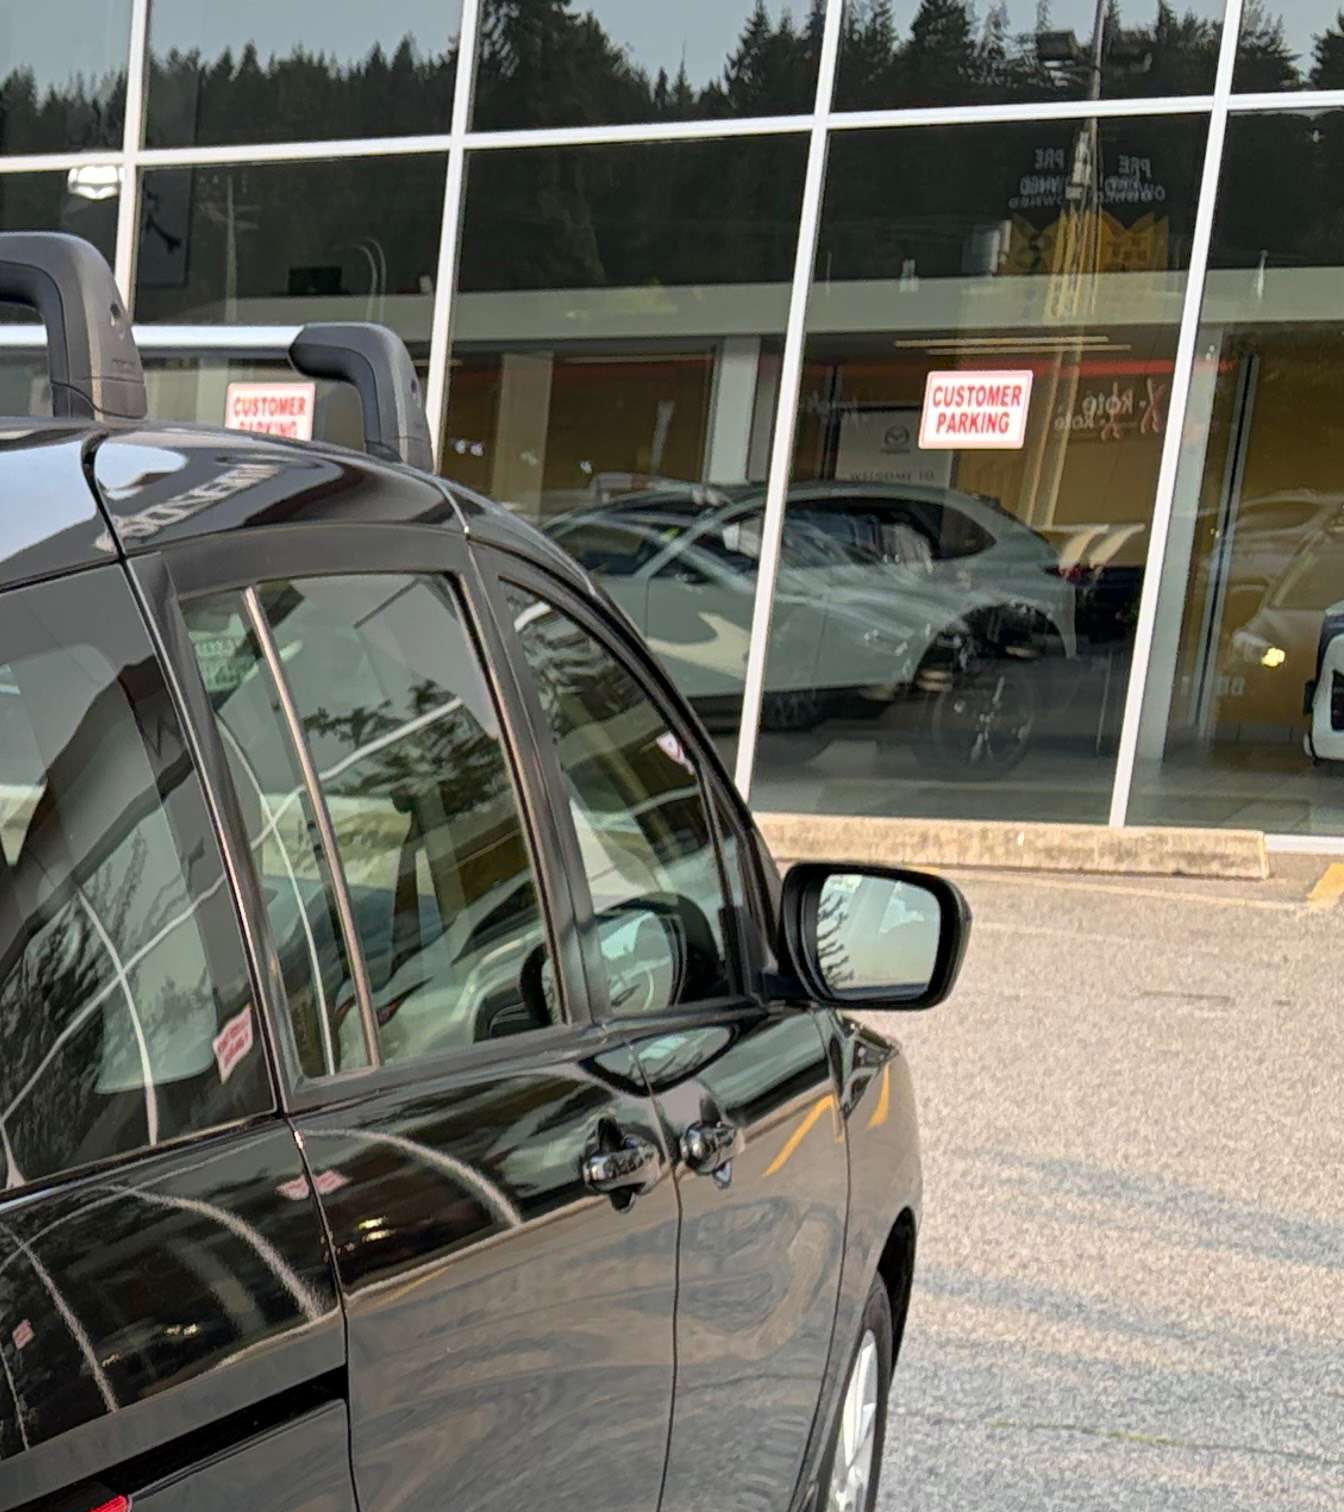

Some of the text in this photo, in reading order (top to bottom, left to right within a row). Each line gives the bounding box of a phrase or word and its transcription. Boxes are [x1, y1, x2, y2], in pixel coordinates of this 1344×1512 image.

[234, 396, 306, 417] CUSTOMER
[932, 384, 1023, 409] CUSTOMER
[935, 411, 1010, 435] PARKING
